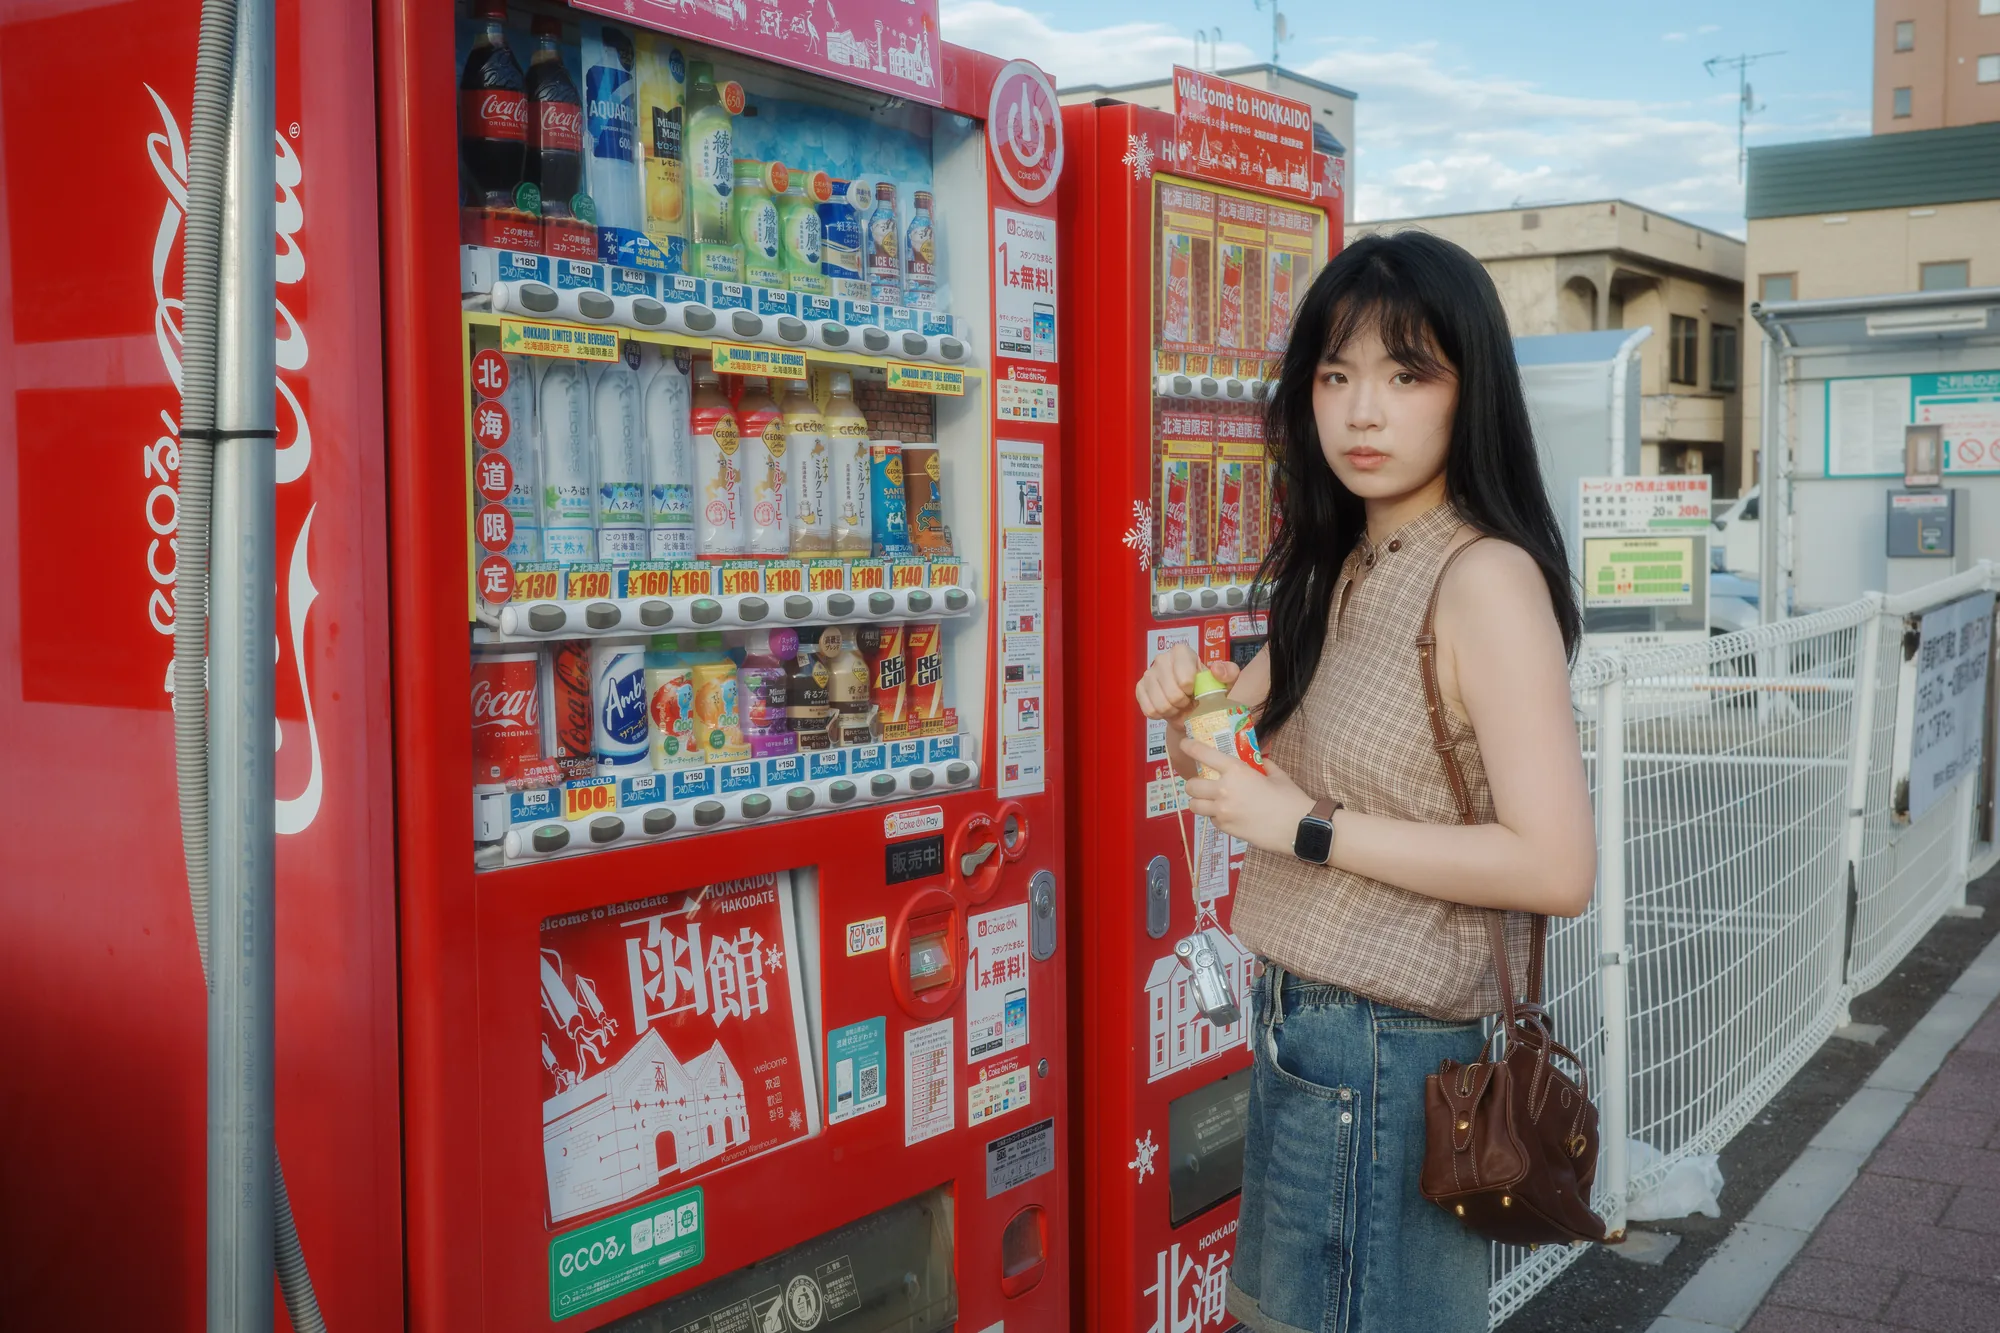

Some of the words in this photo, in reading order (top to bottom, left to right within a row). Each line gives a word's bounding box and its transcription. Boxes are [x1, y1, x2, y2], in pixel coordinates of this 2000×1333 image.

[1177, 75, 1235, 111] Welcome
[1236, 93, 1249, 115] to
[1251, 97, 1311, 132] HOKKAIDO
[661, 128, 681, 140] Maid
[713, 129, 731, 182] 綾鷹
[1018, 170, 1032, 180] Coke
[1163, 188, 1214, 213] 北海道限定!
[1219, 201, 1267, 226] 北海道限定!
[1268, 212, 1313, 232] 北海道限定!
[763, 206, 778, 247] 綾鷹
[805, 213, 820, 253] 綾鷹
[1016, 226, 1034, 240] Coke
[514, 256, 536, 267] ¥180
[571, 264, 591, 276] ¥180
[875, 255, 888, 266] ICE
[913, 262, 926, 273] ICE
[624, 270, 643, 281] ¥180
[677, 280, 694, 289] ¥170
[723, 284, 741, 295] ¥160
[768, 291, 786, 302] ¥150
[522, 325, 551, 341] HOKKAIDO
[551, 328, 573, 343] LIMITED
[573, 331, 586, 345] SALE
[587, 333, 616, 347] BEVERAGES
[729, 347, 752, 361] HOKKAIDO
[752, 350, 769, 363] LIMITED
[770, 352, 780, 364] SALE
[781, 353, 804, 367] BEVERAGES
[1185, 356, 1209, 374] ¥150
[1212, 358, 1233, 376] ¥150
[1016, 370, 1030, 380] Coke
[1037, 372, 1047, 384] Pay
[1162, 416, 1213, 436] 北海道限定!
[725, 458, 736, 530] ミルクコーヒー
[774, 460, 784, 531] ミルクコーヒー
[813, 459, 824, 527] ミルクコーヒー
[858, 461, 866, 528] ミルクコーヒー
[550, 542, 585, 556] 天然水
[513, 572, 557, 599] ¥130
[568, 572, 610, 598] ¥130
[628, 571, 669, 596] ¥160
[671, 571, 710, 595] ¥160
[724, 570, 760, 593] ¥180
[766, 569, 801, 592] ¥180
[810, 568, 843, 591] ¥180
[852, 567, 884, 589] ¥180
[892, 566, 924, 587] ¥140
[930, 565, 959, 586] ¥140
[1205, 625, 1225, 640] Coca-Cola
[494, 730, 533, 738] ORIGINAL
[732, 766, 749, 774] ¥150
[778, 760, 795, 769] ¥150
[591, 777, 612, 787] COLD
[635, 778, 653, 787] ¥150
[685, 772, 703, 780] ¥150
[527, 794, 546, 803] ¥150
[567, 786, 616, 813] 100円
[899, 818, 915, 831] Coke
[926, 816, 939, 829] Pay
[891, 845, 937, 874] 販売中
[705, 872, 776, 900] HOKKAIDO
[720, 890, 775, 915] HAKODATE
[540, 910, 588, 932] elcome
[591, 906, 604, 920] to
[607, 894, 669, 916] Hakodate
[866, 926, 884, 936] 使えます
[987, 923, 1006, 936] Coke
[868, 935, 881, 947] OK
[620, 895, 769, 1036] 函館
[753, 1055, 788, 1075] welcome
[987, 1068, 1001, 1079] Coke
[1008, 1061, 1019, 1072] Pay
[765, 1075, 782, 1091] 欢迎
[768, 1106, 786, 1122] 환영
[972, 1110, 983, 1120] VISA
[721, 1144, 747, 1164] Kanamori
[747, 1137, 778, 1155] Warehouse
